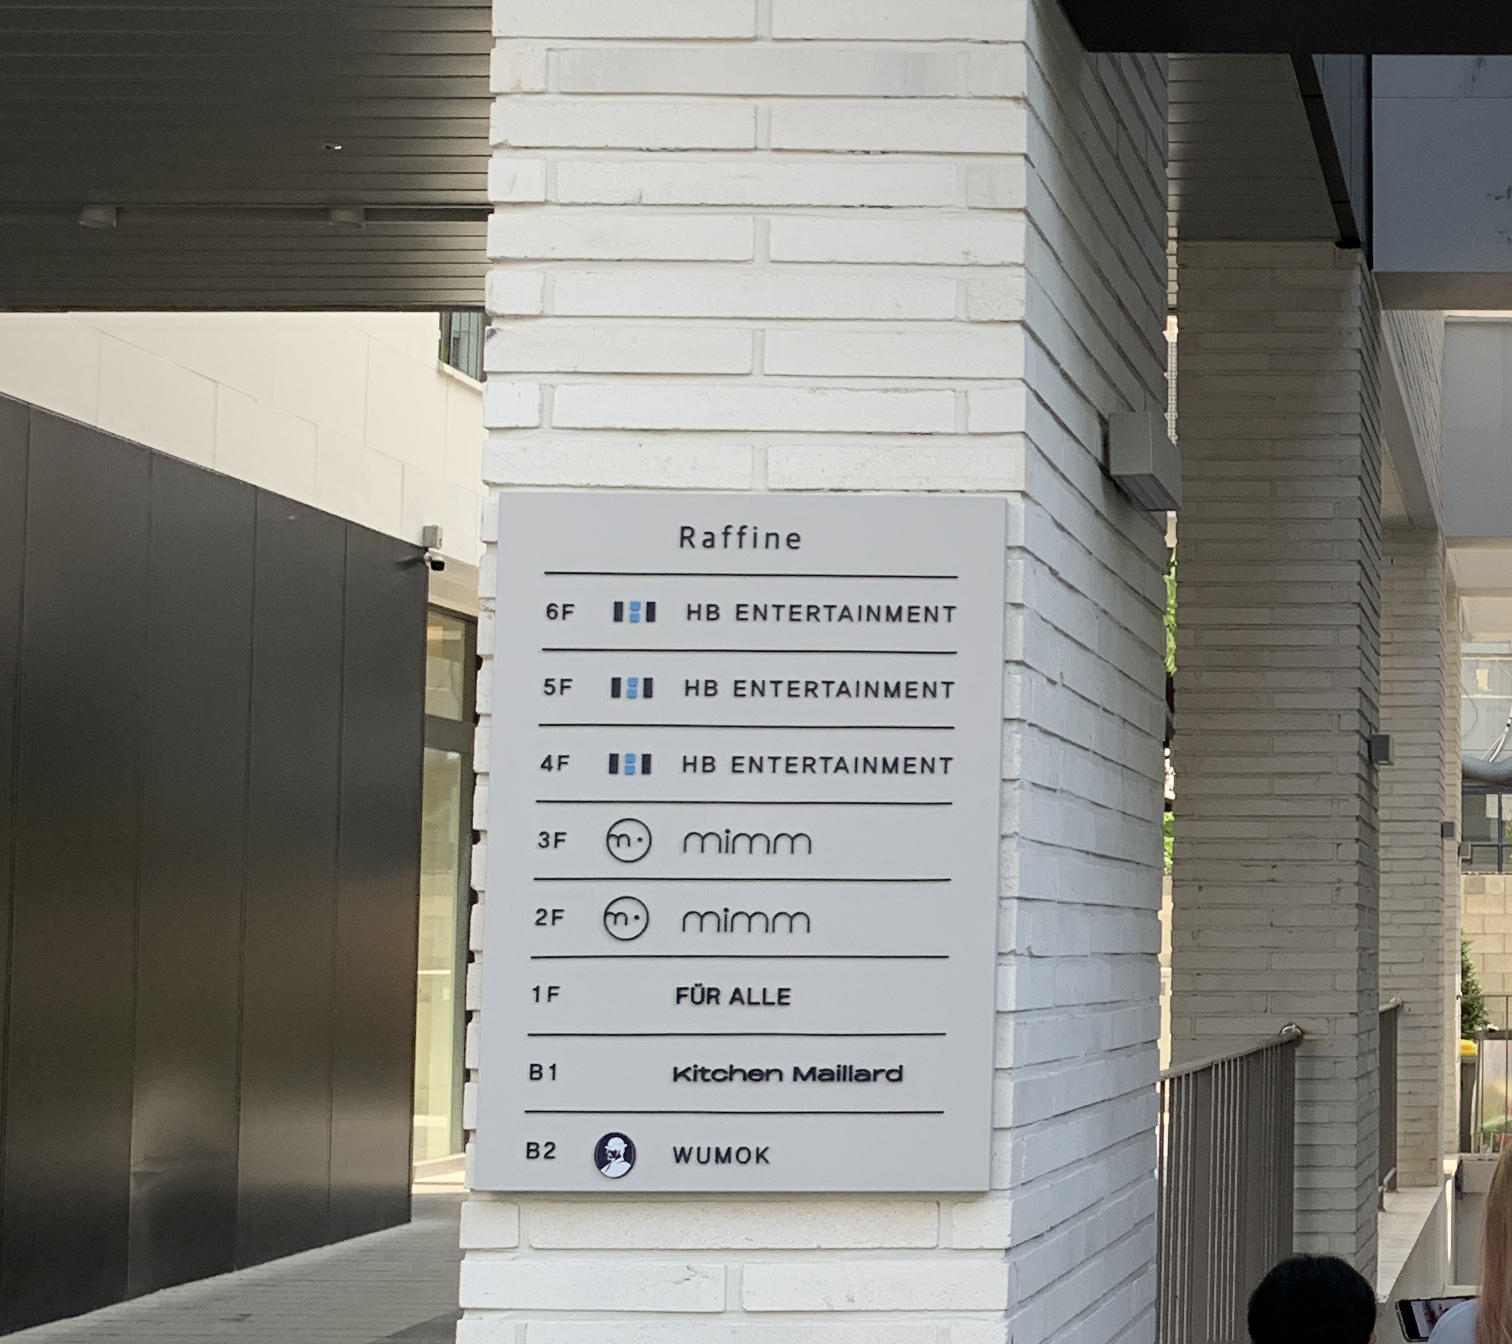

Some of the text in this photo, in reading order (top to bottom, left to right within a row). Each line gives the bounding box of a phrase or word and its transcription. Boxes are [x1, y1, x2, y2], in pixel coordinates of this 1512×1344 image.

[679, 524, 802, 550] Raffine
[546, 602, 957, 624] 6F HB ENTERTAINMENT
[543, 678, 955, 699] 5F HB ENTERTAINMENT
[540, 754, 954, 775] 4F HB ENTERTAINMENT
[537, 831, 567, 849] 3F
[682, 828, 812, 855] mimm
[534, 908, 565, 927] 2F
[682, 907, 811, 934] mimm
[532, 982, 791, 1007] 1F FÜR ALLE
[529, 1063, 904, 1083] B1 Kitchen Maillard
[526, 1141, 770, 1165] B2 WUMOK
